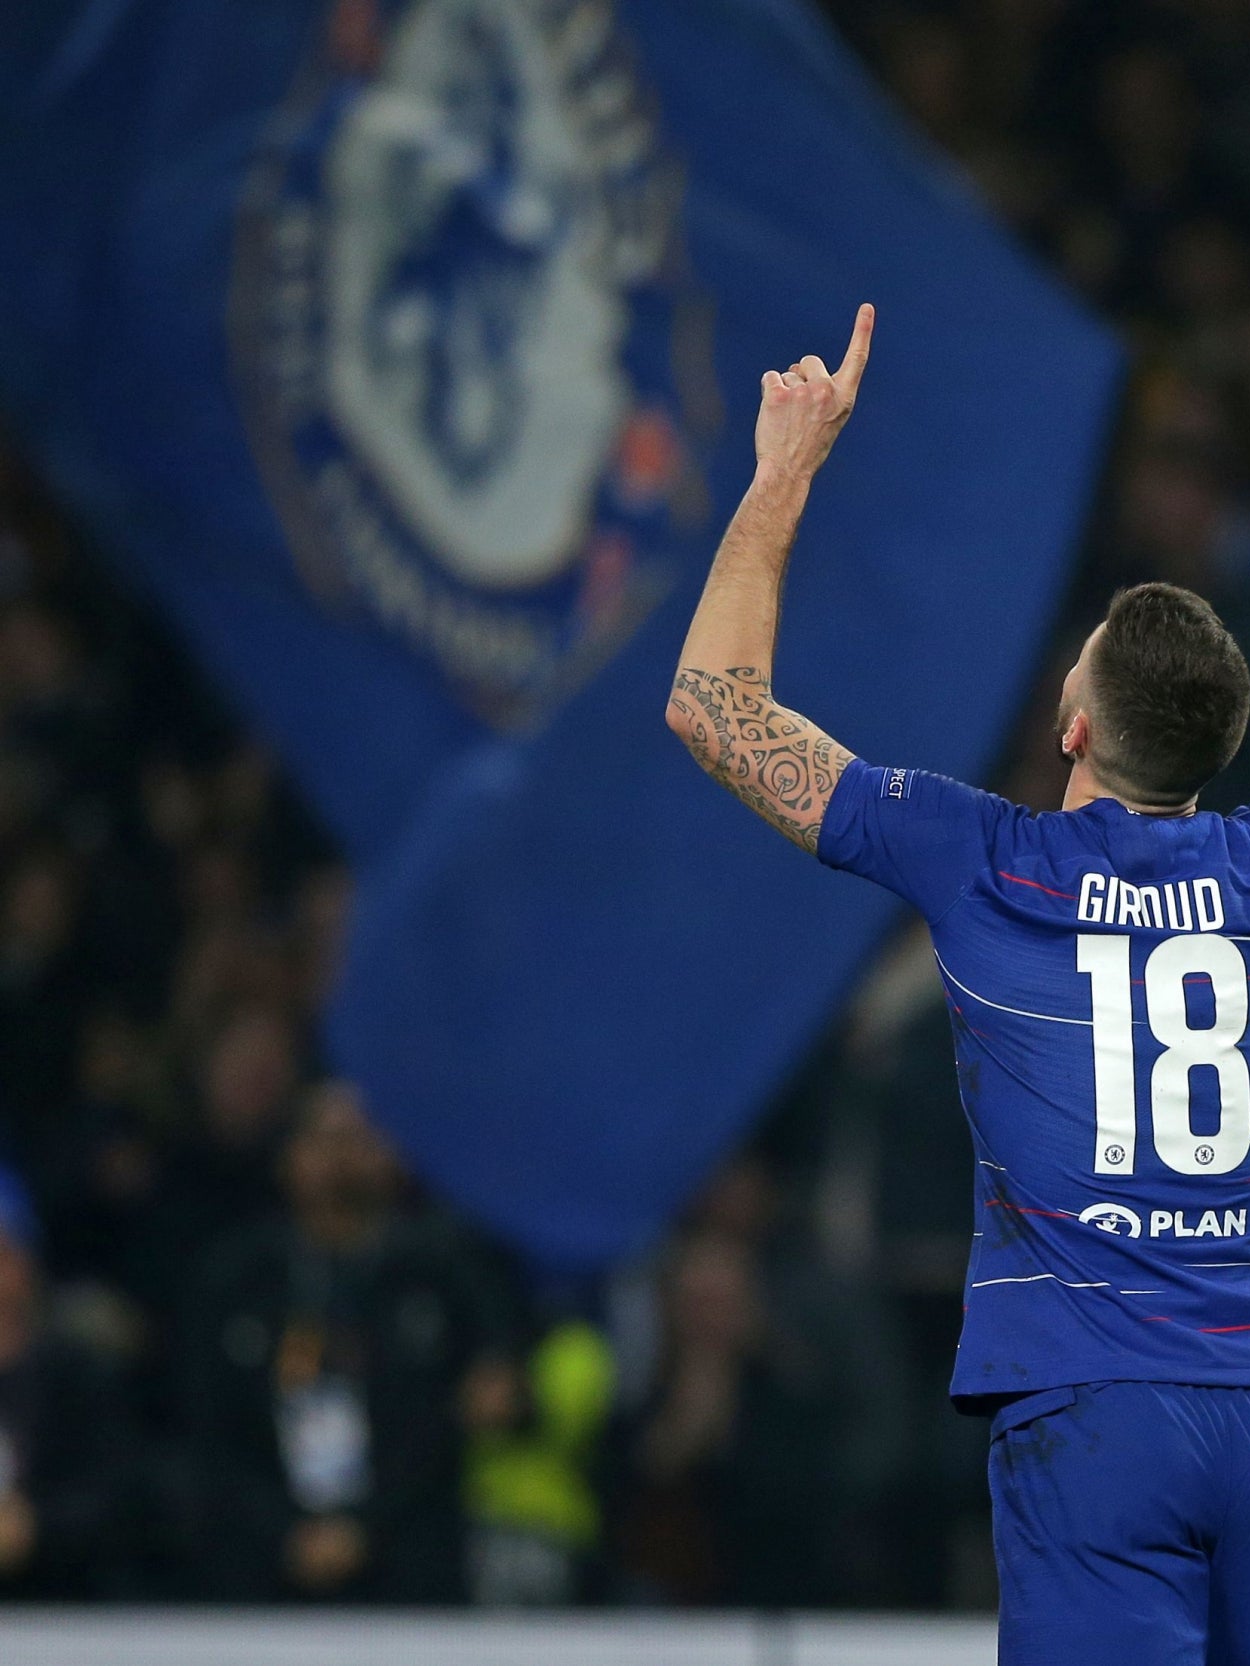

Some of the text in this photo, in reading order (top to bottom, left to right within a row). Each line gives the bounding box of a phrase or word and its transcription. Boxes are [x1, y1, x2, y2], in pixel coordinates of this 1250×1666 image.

[1077, 872, 1225, 932] GIROUD
[1076, 934, 1250, 1175] 18
[1150, 1208, 1247, 1238] PLAN
